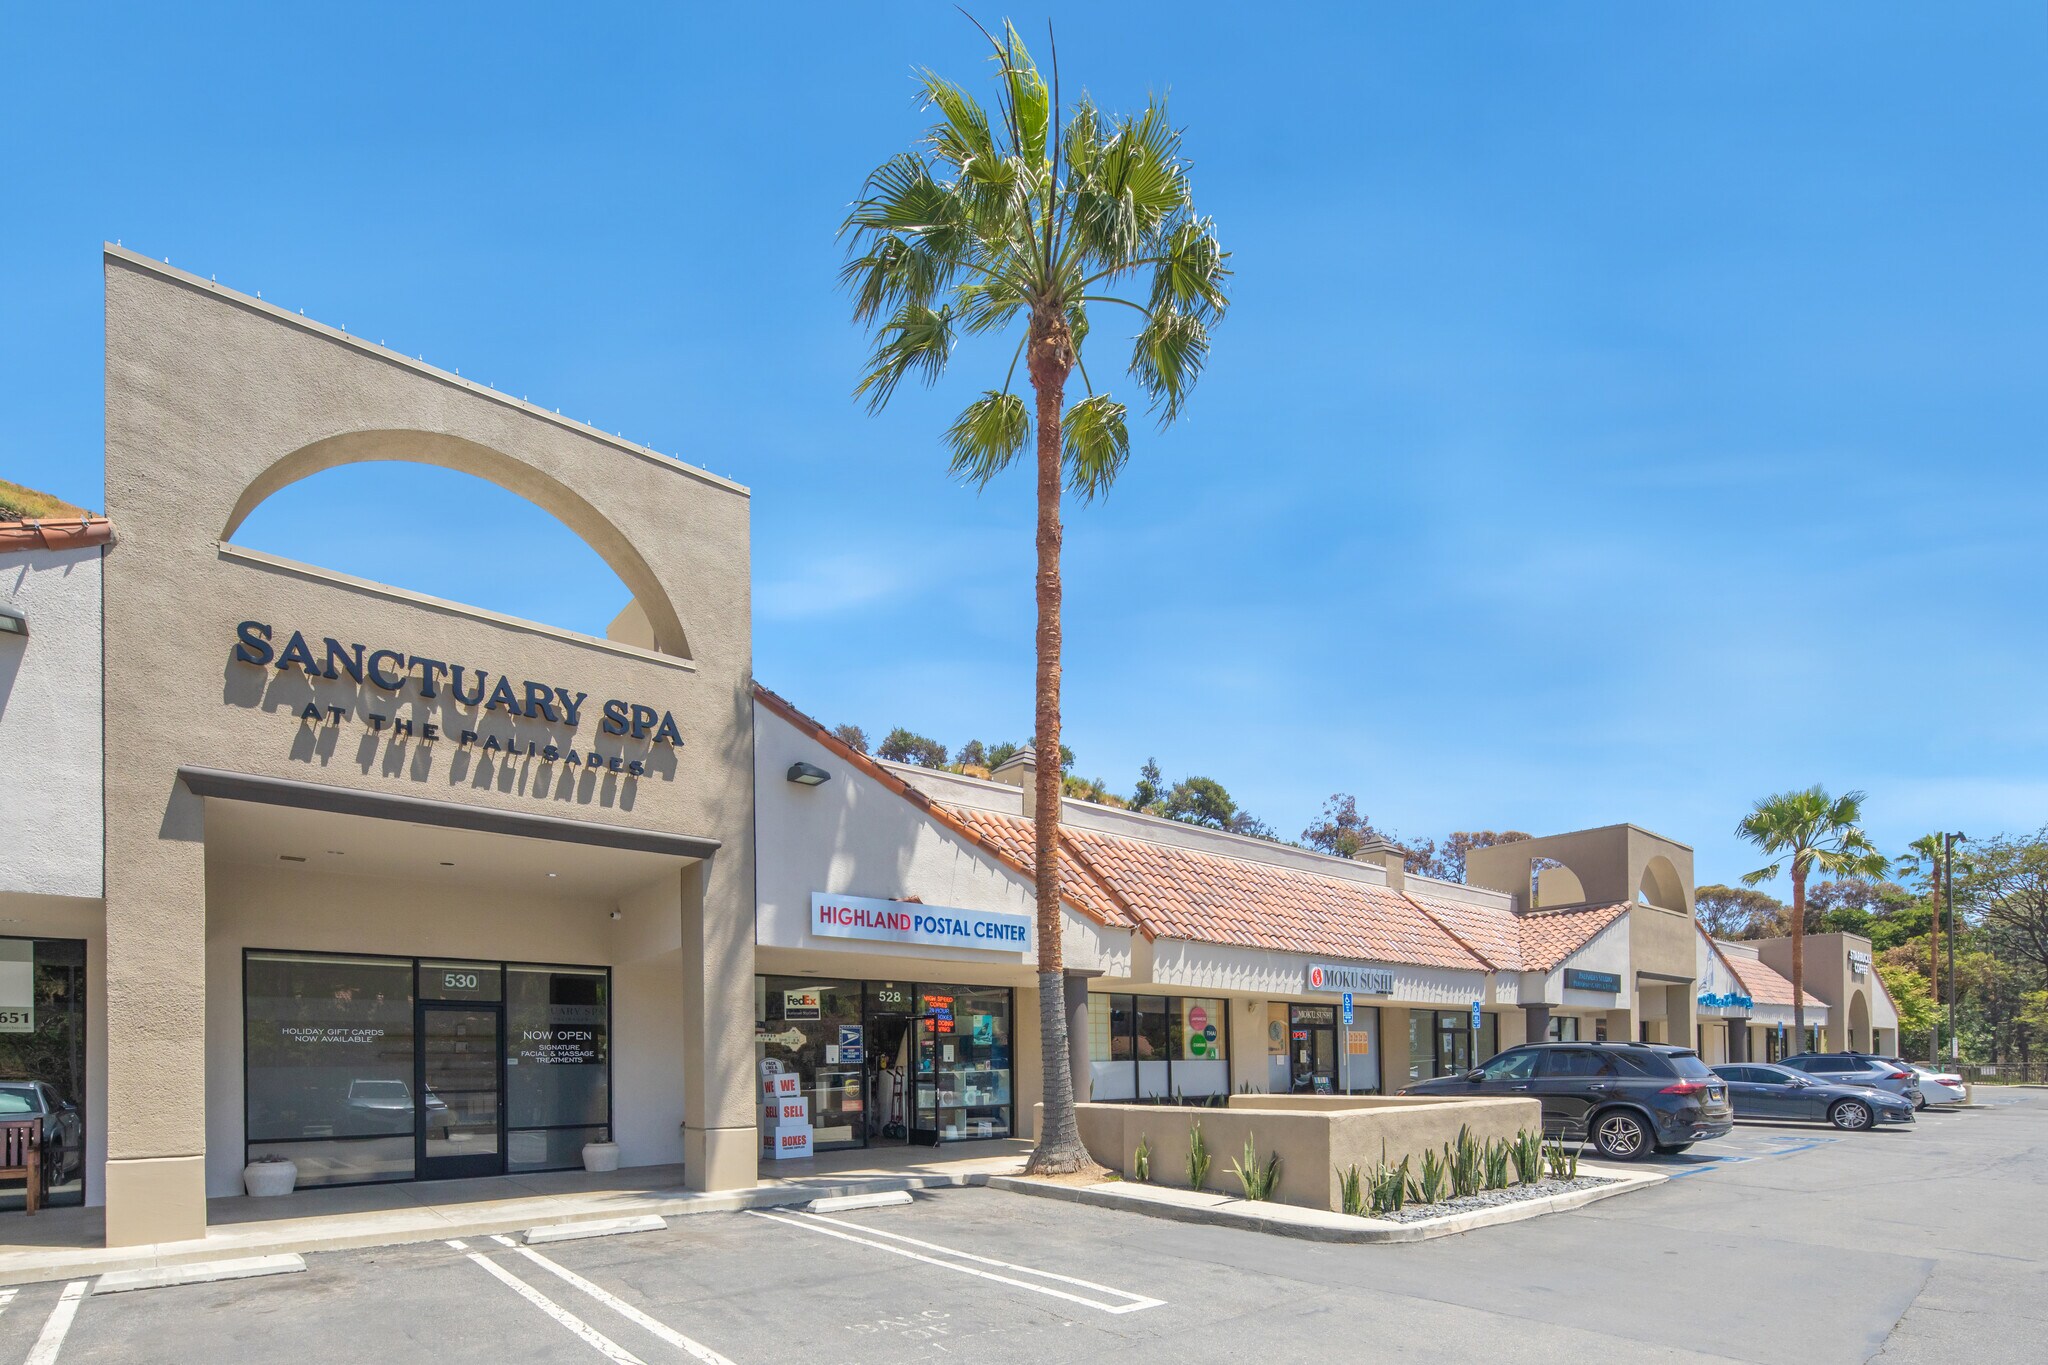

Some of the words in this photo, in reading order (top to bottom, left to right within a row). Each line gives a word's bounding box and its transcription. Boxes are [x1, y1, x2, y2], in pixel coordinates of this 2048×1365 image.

[236, 620, 588, 726] SANCTUARY
[602, 699, 685, 747] SPA
[301, 702, 346, 726] AT
[368, 713, 440, 742] THE
[460, 729, 645, 777] PALISADES
[819, 905, 911, 932] HIGHLAND
[914, 914, 971, 937] POSTAL
[973, 920, 1026, 942] CENTER
[444, 973, 477, 988] 530
[1324, 969, 1358, 988] MOKU
[1360, 973, 1392, 990] SUSHI
[787, 994, 817, 1006] FedEx
[878, 990, 901, 1003] 528
[1298, 1009, 1316, 1019] MOKU
[1316, 1011, 1333, 1020] SUSHI
[523, 1030, 553, 1040] NOW
[557, 1031, 592, 1040] OPEN
[1292, 1031, 1307, 1039] OPEN
[764, 1081, 774, 1093] WE
[780, 1079, 796, 1092] WE
[766, 1106, 778, 1118] SELL
[784, 1106, 804, 1118] SELL
[782, 1134, 806, 1146] BOXES
